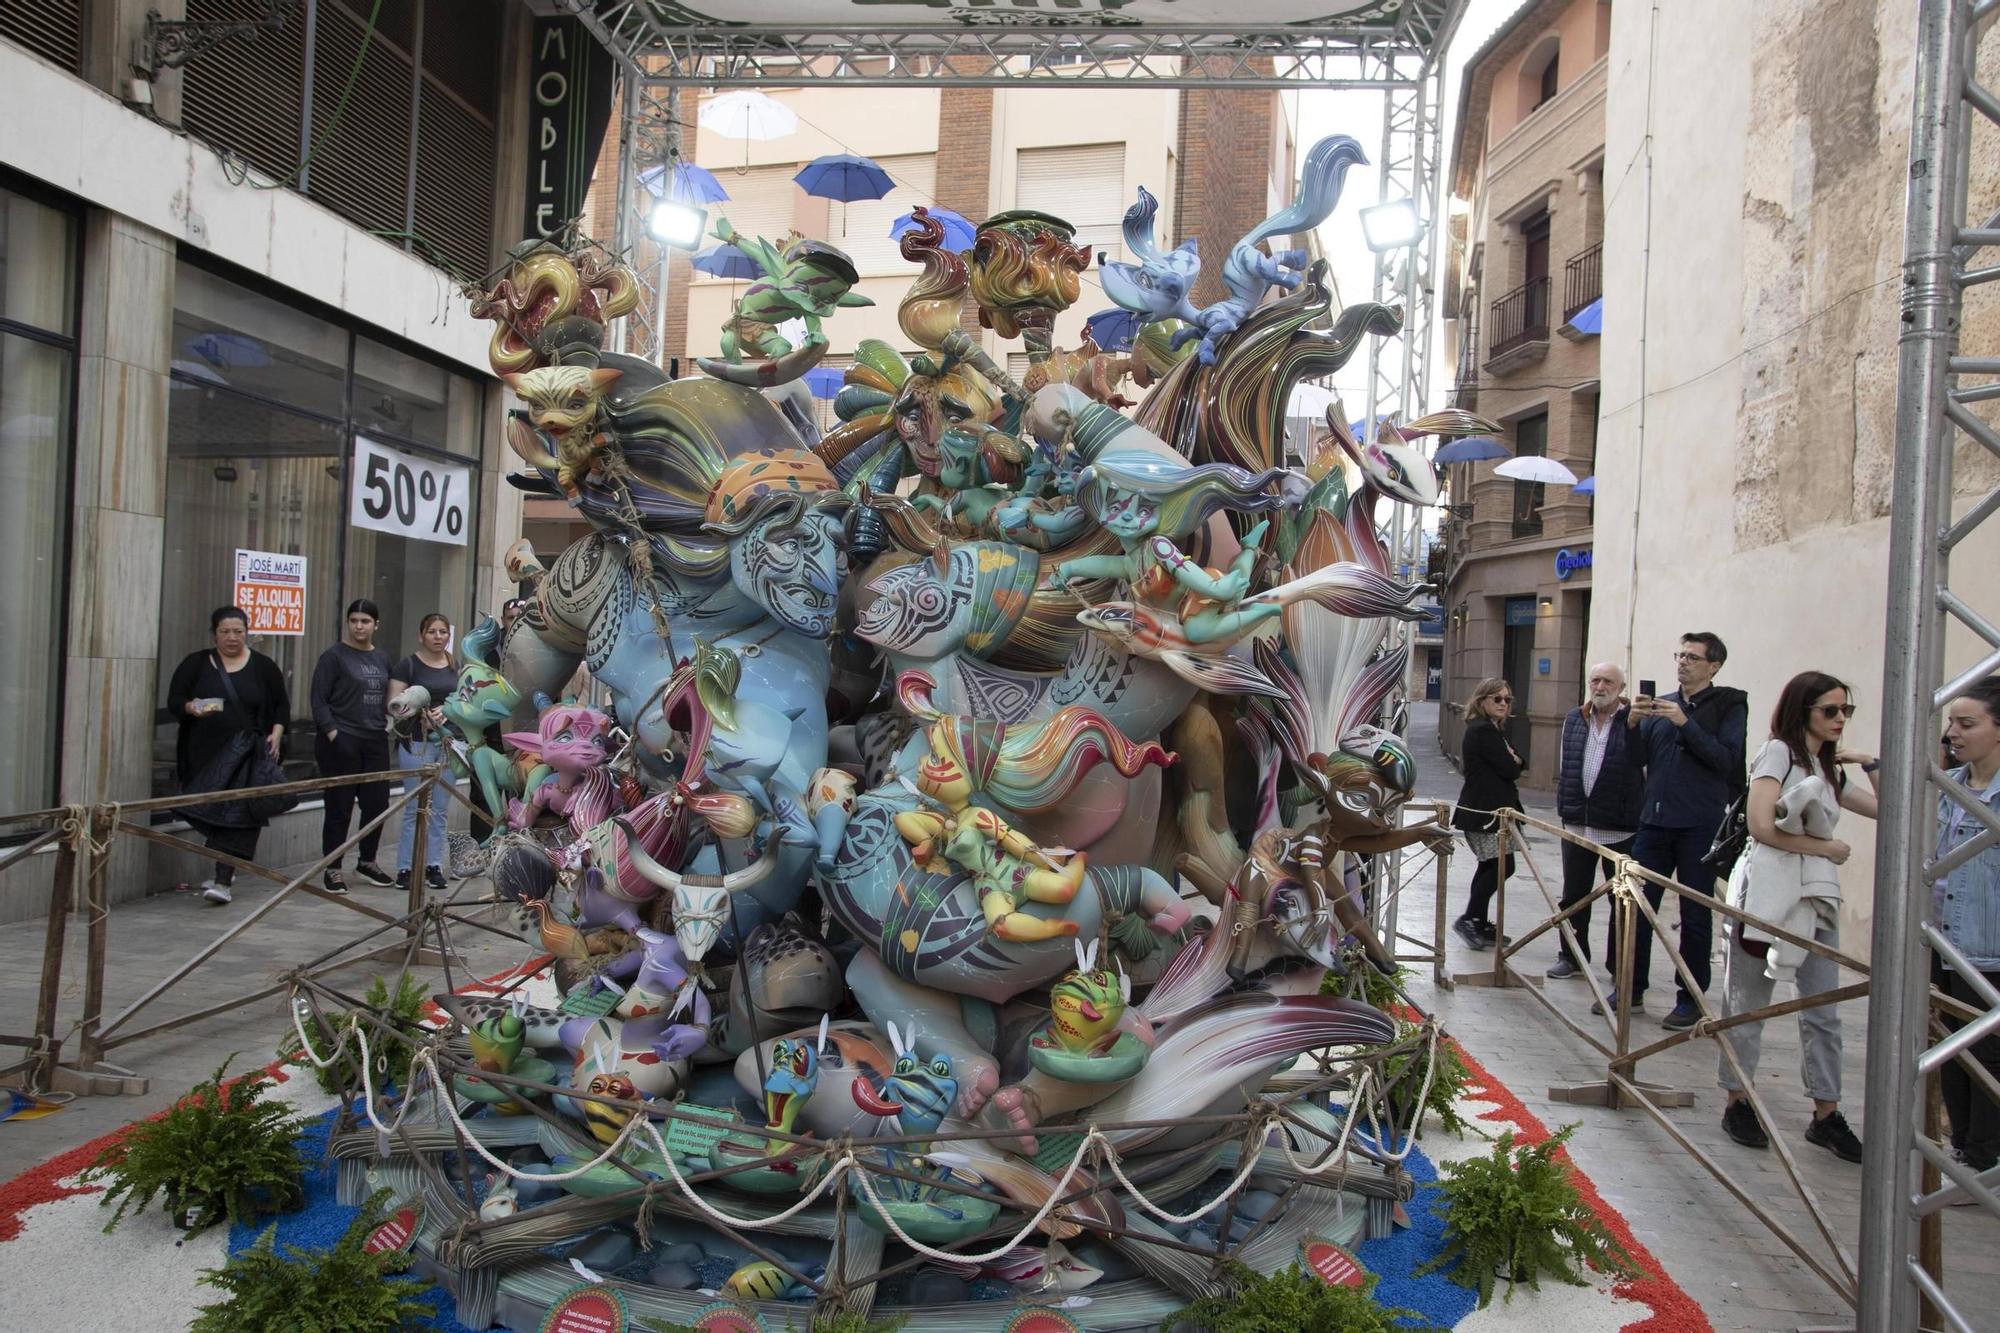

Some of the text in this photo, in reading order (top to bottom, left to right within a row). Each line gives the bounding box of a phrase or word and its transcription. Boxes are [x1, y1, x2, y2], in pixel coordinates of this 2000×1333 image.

[362, 452, 463, 537] 50%
[249, 556, 301, 575] JOSÉ MARTÍ
[239, 587, 302, 609] SE ALQUILA
[254, 607, 273, 629] 240
[274, 608, 287, 629] 46
[288, 608, 300, 630] 72
